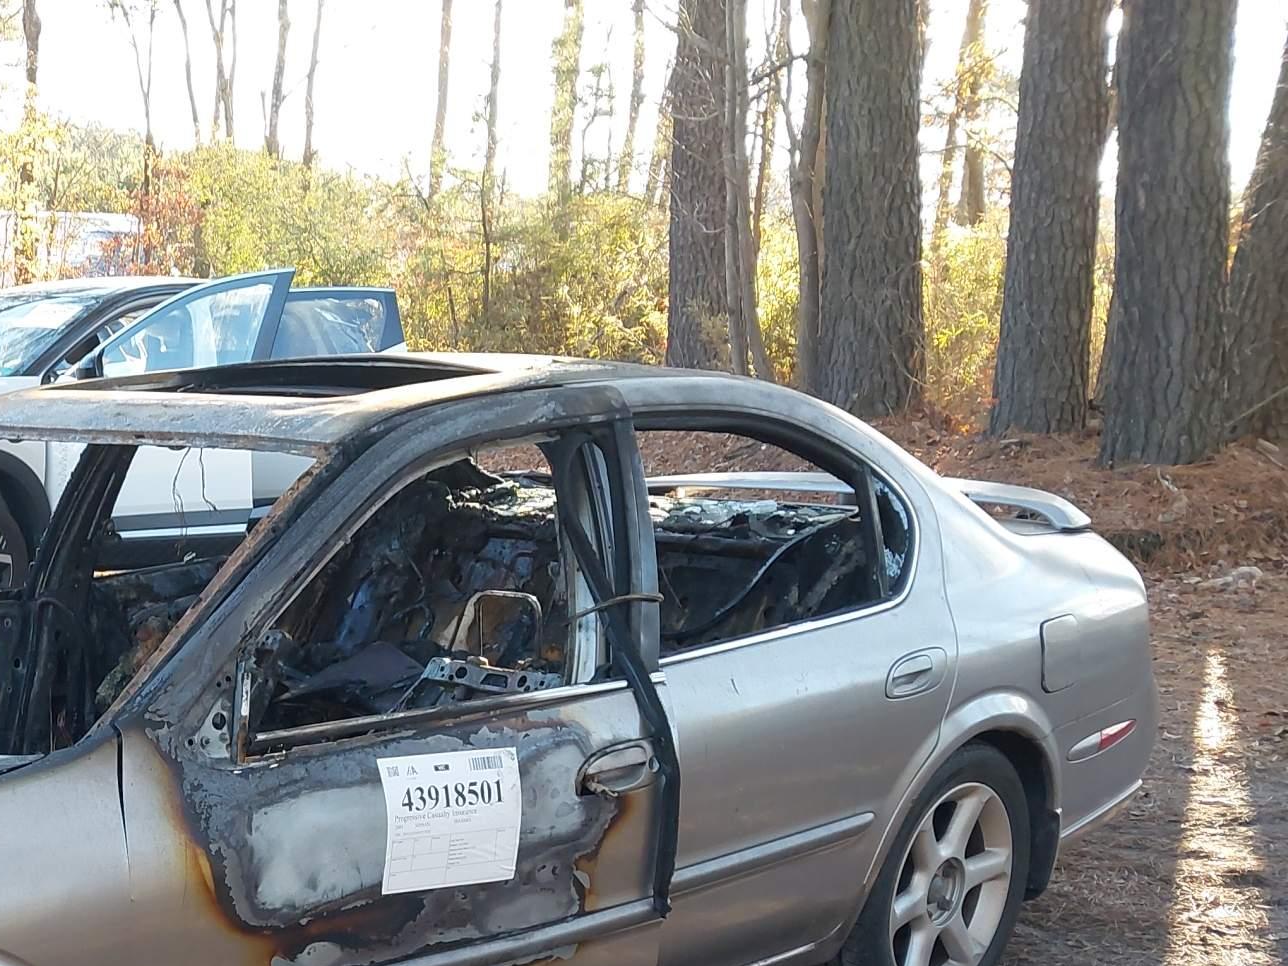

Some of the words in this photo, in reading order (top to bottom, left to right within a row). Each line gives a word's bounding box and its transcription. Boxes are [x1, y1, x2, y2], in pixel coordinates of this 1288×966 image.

[402, 779, 505, 812] 43918501
[426, 809, 451, 820] Casualty
[452, 808, 477, 817] Insurance
